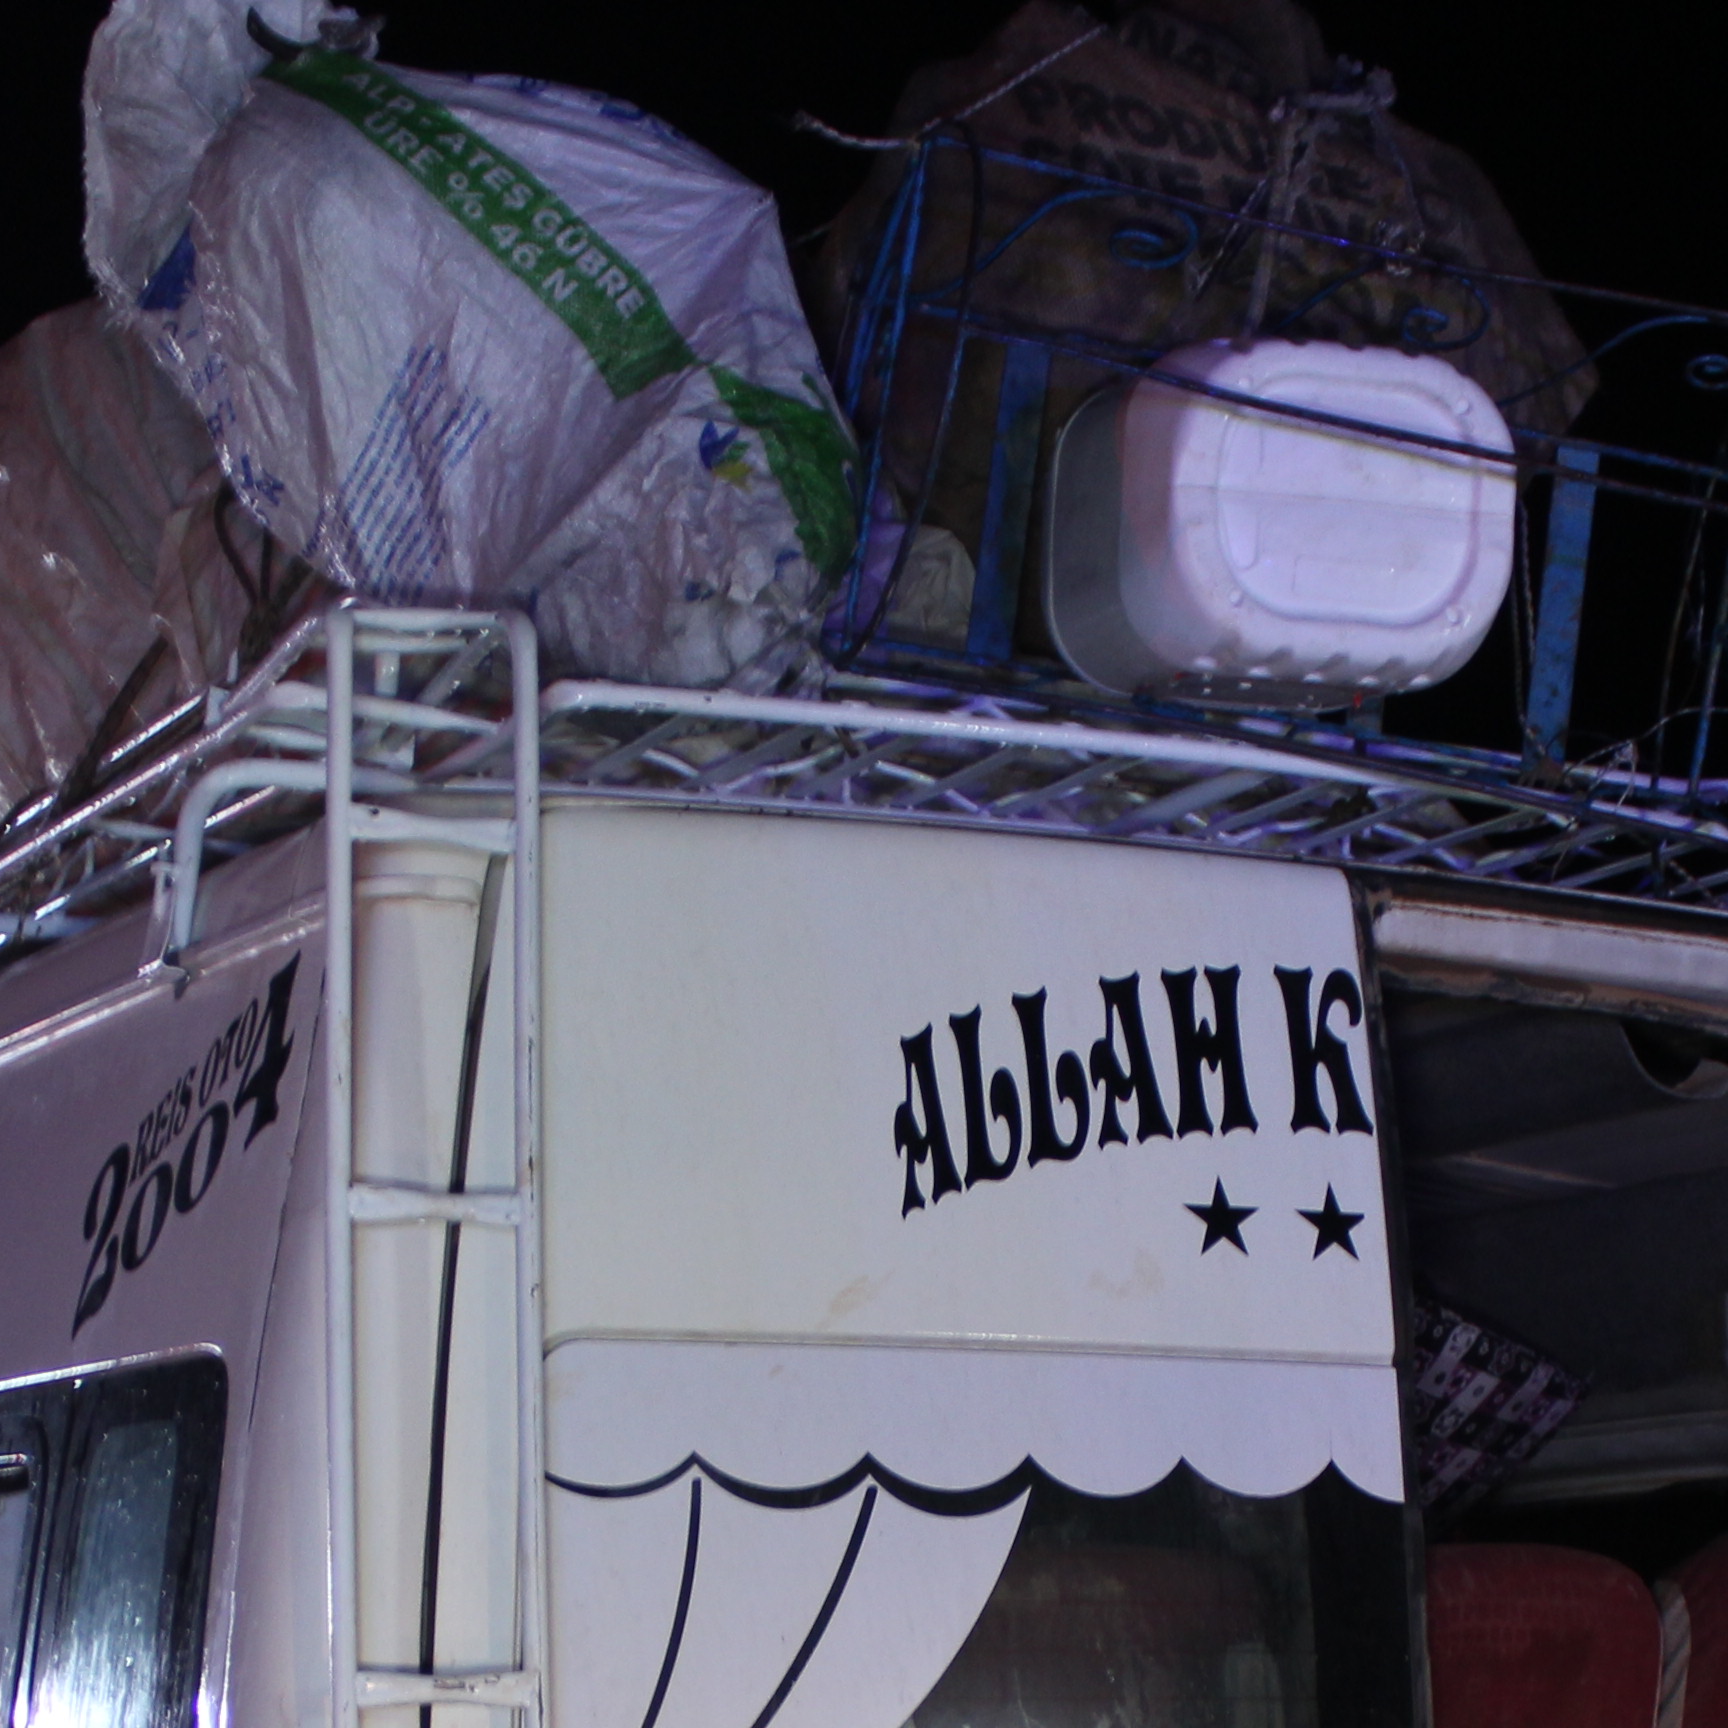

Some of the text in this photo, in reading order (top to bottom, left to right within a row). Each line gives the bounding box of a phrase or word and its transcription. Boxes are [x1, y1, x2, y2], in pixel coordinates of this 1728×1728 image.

[343, 72, 416, 114] ALP
[446, 170, 485, 220] %
[488, 221, 544, 271] 46
[540, 267, 580, 302] N
[71, 948, 303, 1342] 2004
[894, 964, 1260, 1221] ALLAH
